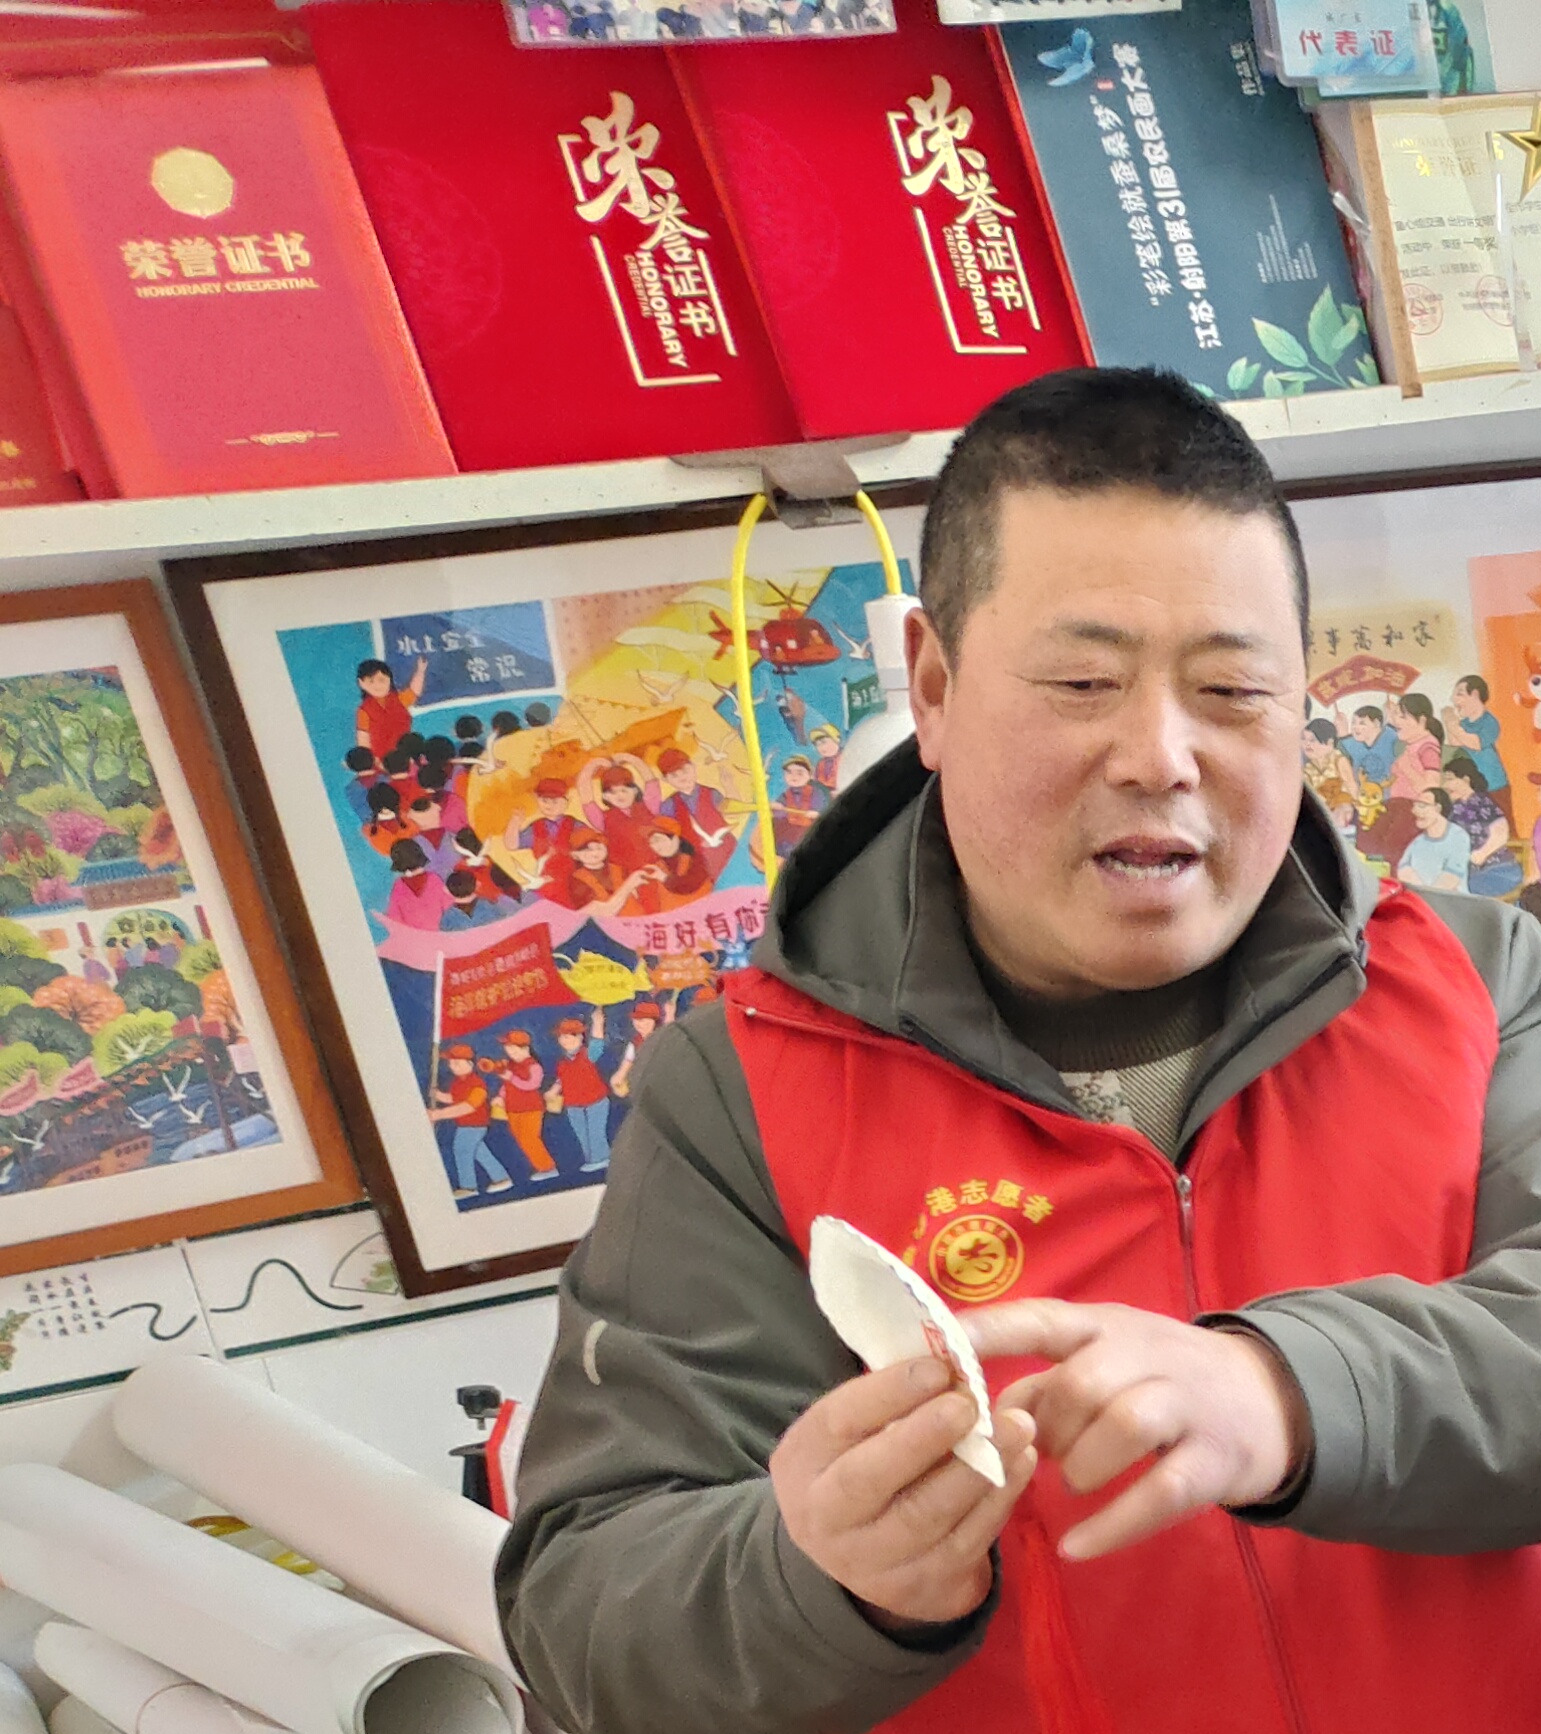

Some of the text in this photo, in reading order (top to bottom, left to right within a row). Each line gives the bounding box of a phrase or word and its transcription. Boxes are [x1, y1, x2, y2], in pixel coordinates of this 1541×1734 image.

[1299, 29, 1395, 56] 代表证
[575, 90, 719, 338] 荣誉证书
[901, 74, 1024, 311] 荣誉证书
[120, 231, 311, 279] 荣誉证书
[624, 254, 651, 318] CREDENTIAL
[942, 226, 967, 288] CREDENTIAL
[952, 225, 1000, 338] HONORARY
[136, 277, 320, 298] HONORARY CREDENTIAL
[636, 251, 689, 368] HONORARY
[397, 631, 485, 656] 水上安全
